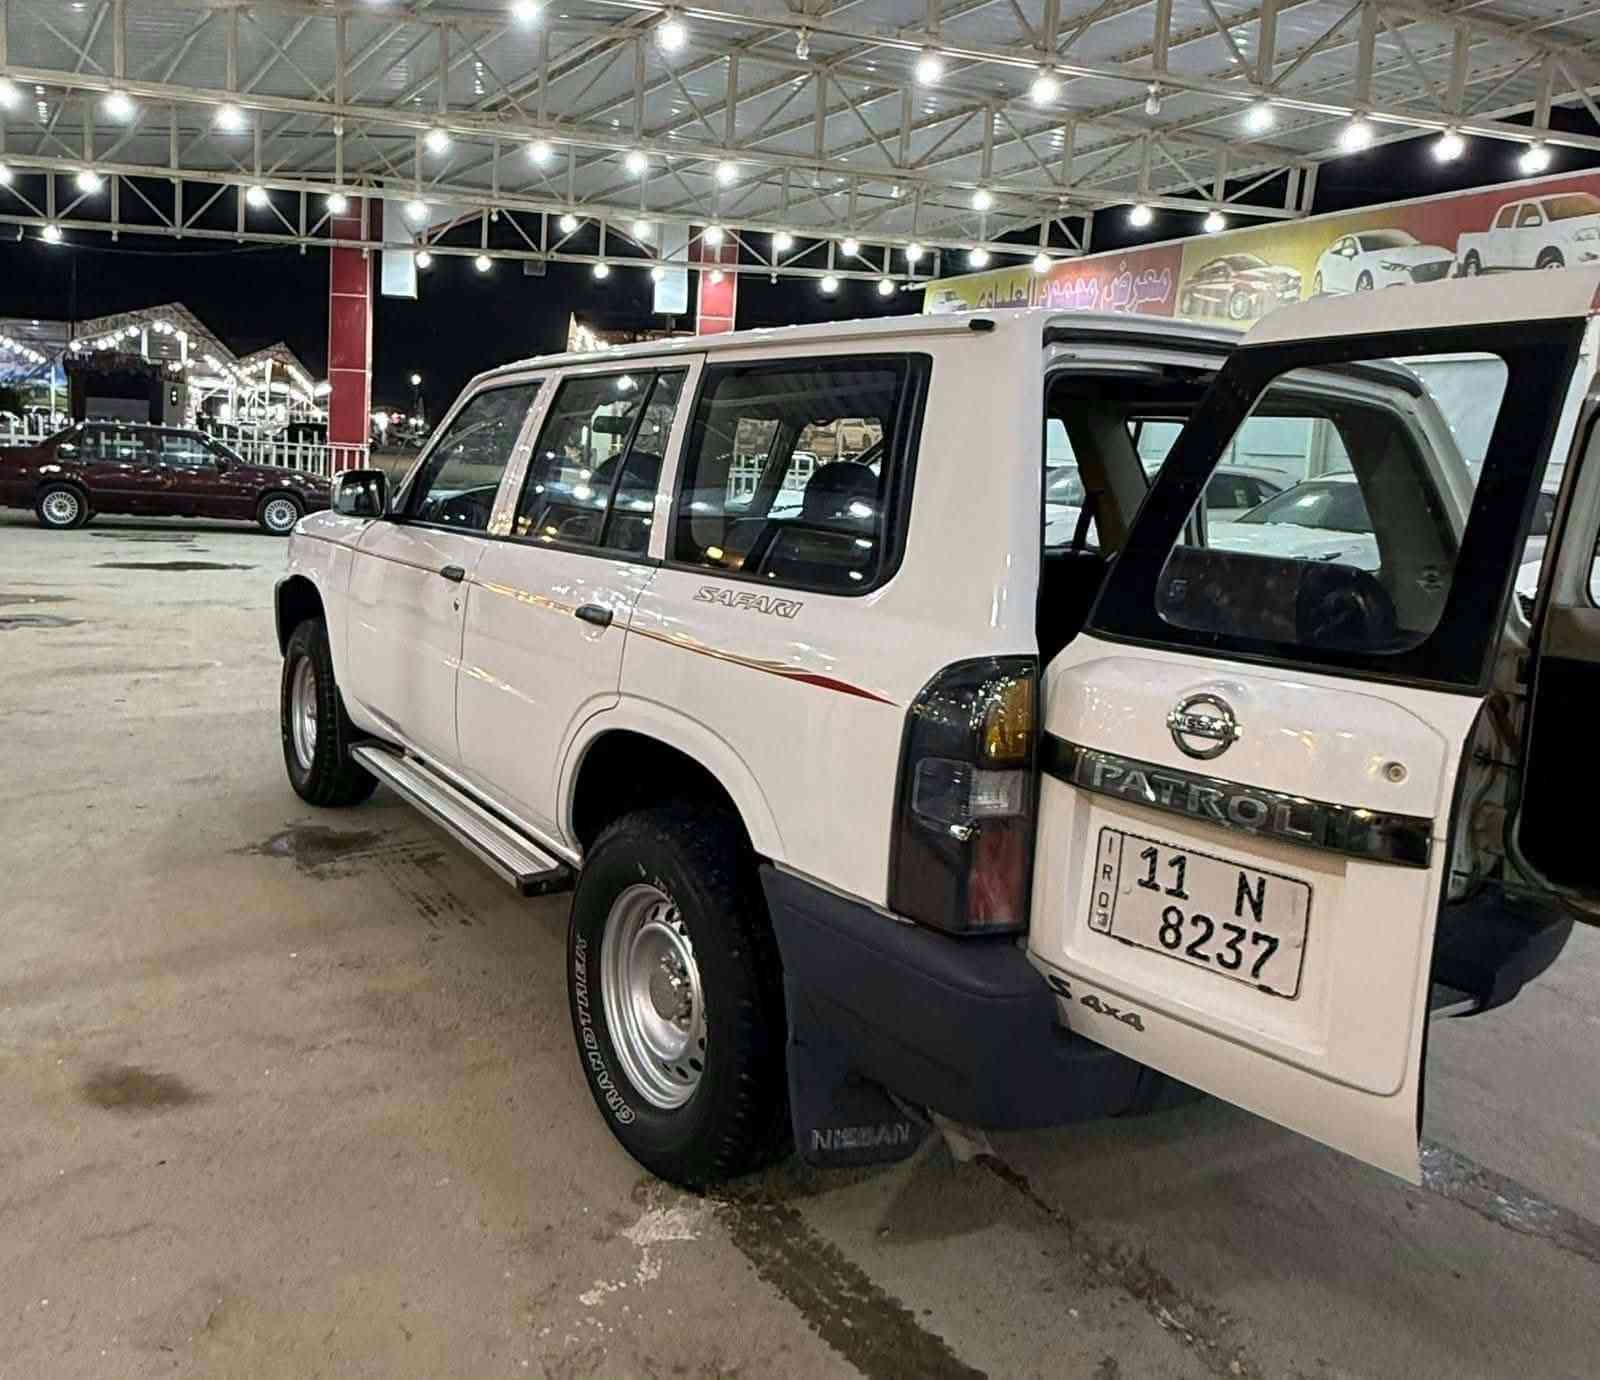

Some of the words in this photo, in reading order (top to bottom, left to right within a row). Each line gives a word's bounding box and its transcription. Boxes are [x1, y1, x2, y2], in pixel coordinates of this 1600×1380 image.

[693, 585, 804, 620] SAFARI
[1092, 763, 1313, 837] PATROL
[1137, 846, 1190, 900] 11
[1234, 870, 1266, 923] N
[1158, 905, 1280, 979] 8237
